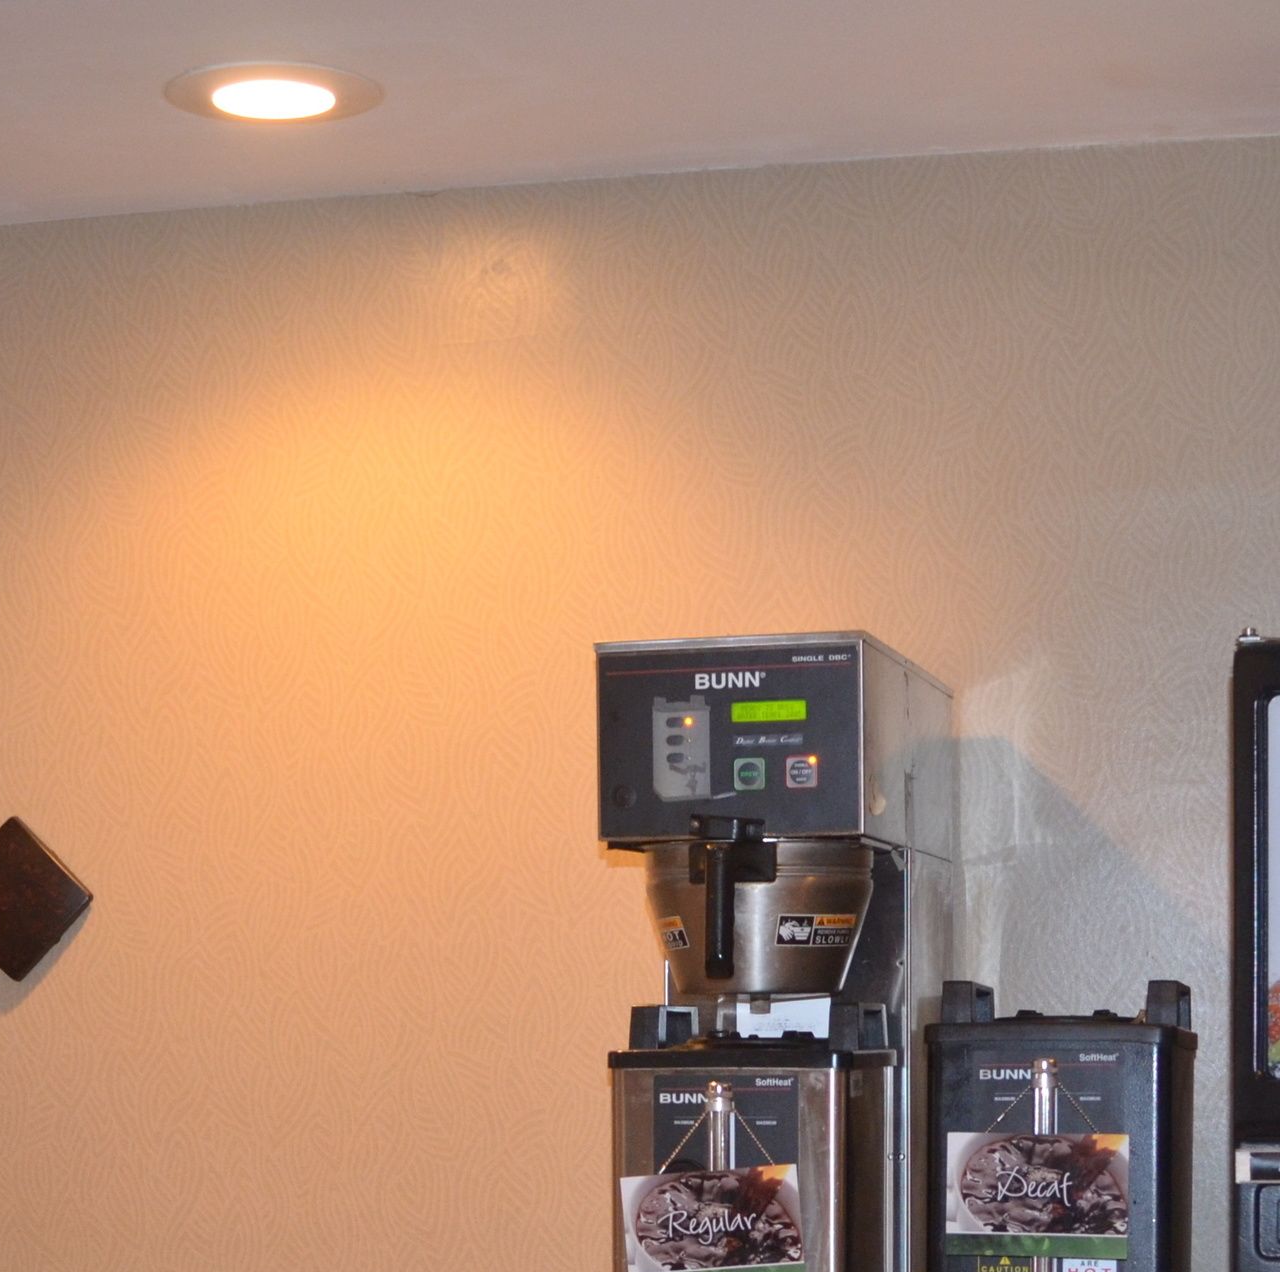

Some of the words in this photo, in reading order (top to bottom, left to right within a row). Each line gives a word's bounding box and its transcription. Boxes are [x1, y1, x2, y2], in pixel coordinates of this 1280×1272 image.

[791, 654, 824, 663] SINGLE
[694, 671, 761, 690] BUNN
[1079, 1053, 1116, 1062] SoftHeat
[979, 1068, 1032, 1080] BUNN
[755, 1077, 792, 1087] SoftHeat
[996, 1166, 1072, 1207] Decaf
[657, 1208, 756, 1245] Regular
